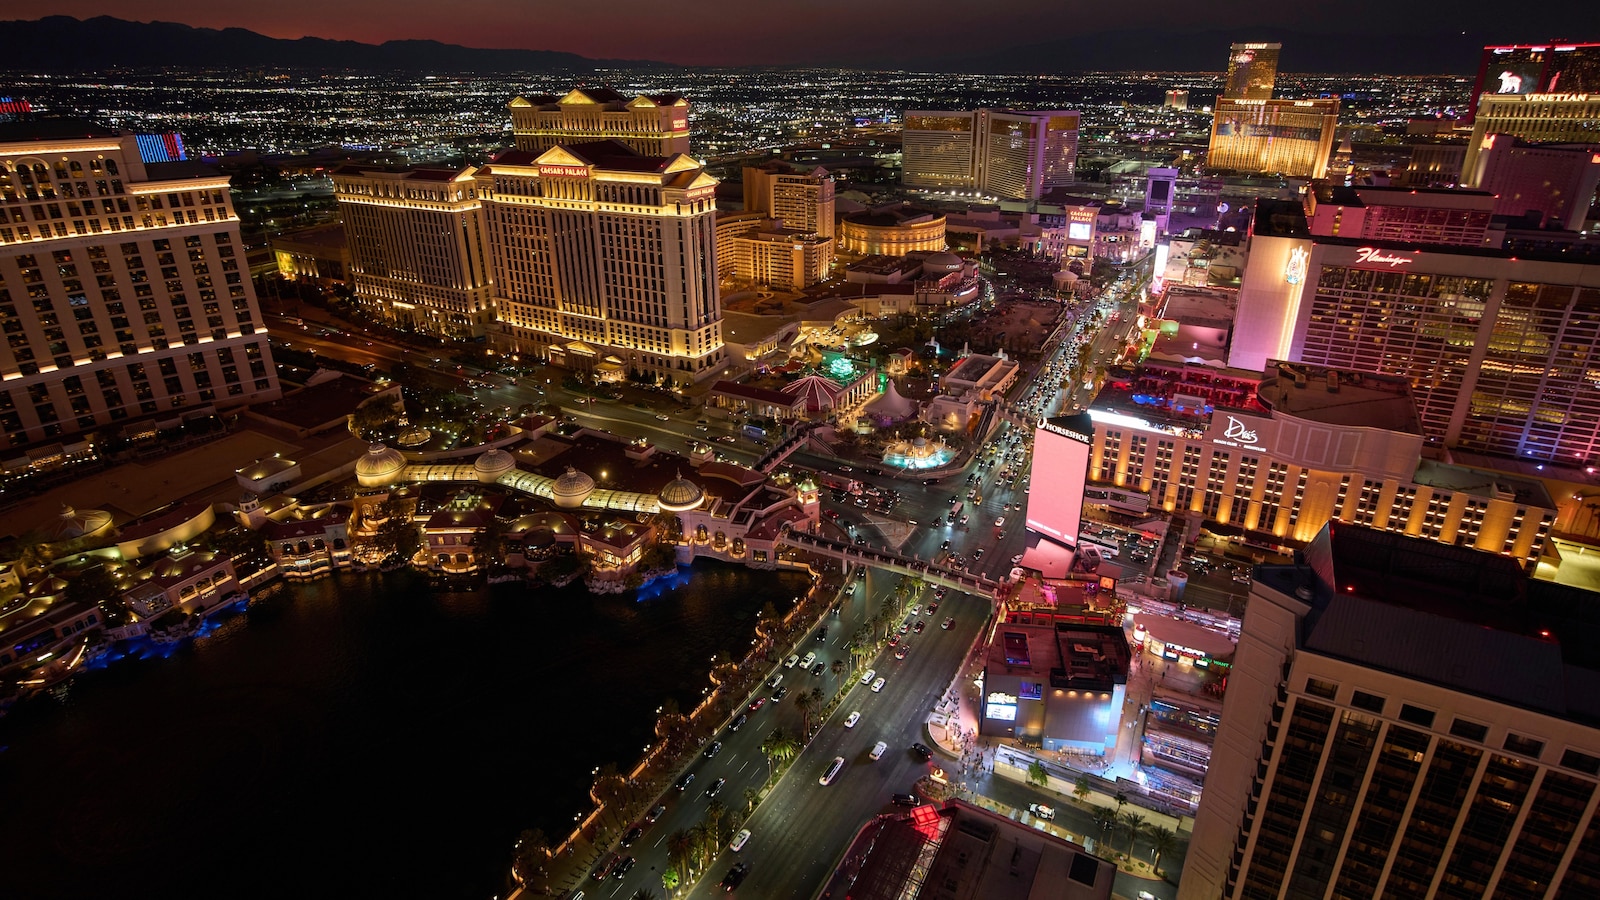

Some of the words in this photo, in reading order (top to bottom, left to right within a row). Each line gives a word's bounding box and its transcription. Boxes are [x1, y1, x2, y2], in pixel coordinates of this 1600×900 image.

[1525, 94, 1587, 102] VENETIAN
[540, 167, 564, 175] CAESARS
[564, 168, 588, 177] PALACE
[1355, 247, 1413, 267] Flamingo
[1046, 423, 1089, 443] HORSESHOE
